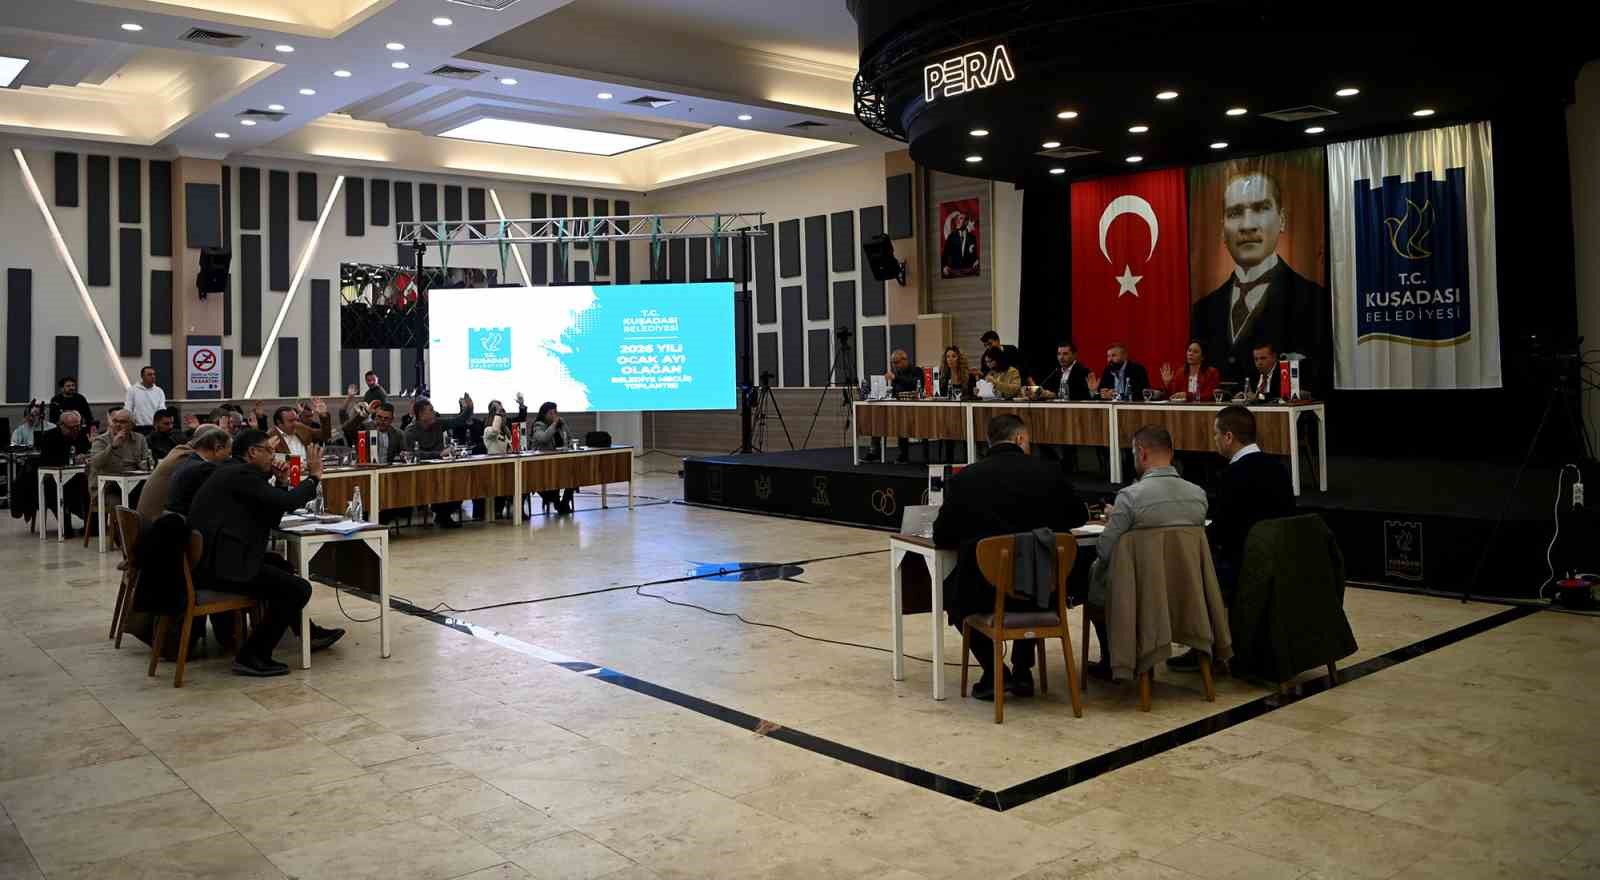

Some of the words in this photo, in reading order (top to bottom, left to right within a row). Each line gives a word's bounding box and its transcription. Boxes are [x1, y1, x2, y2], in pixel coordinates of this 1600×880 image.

[924, 44, 1015, 102] PERA
[1398, 272, 1427, 285] T.C.
[1366, 288, 1460, 307] KUŞADASI
[1366, 307, 1460, 322] BELEDİYESİ
[656, 344, 683, 353] YILI
[617, 355, 657, 365] OCAK
[662, 354, 687, 364] AYI
[621, 364, 682, 375] OLAĞAN
